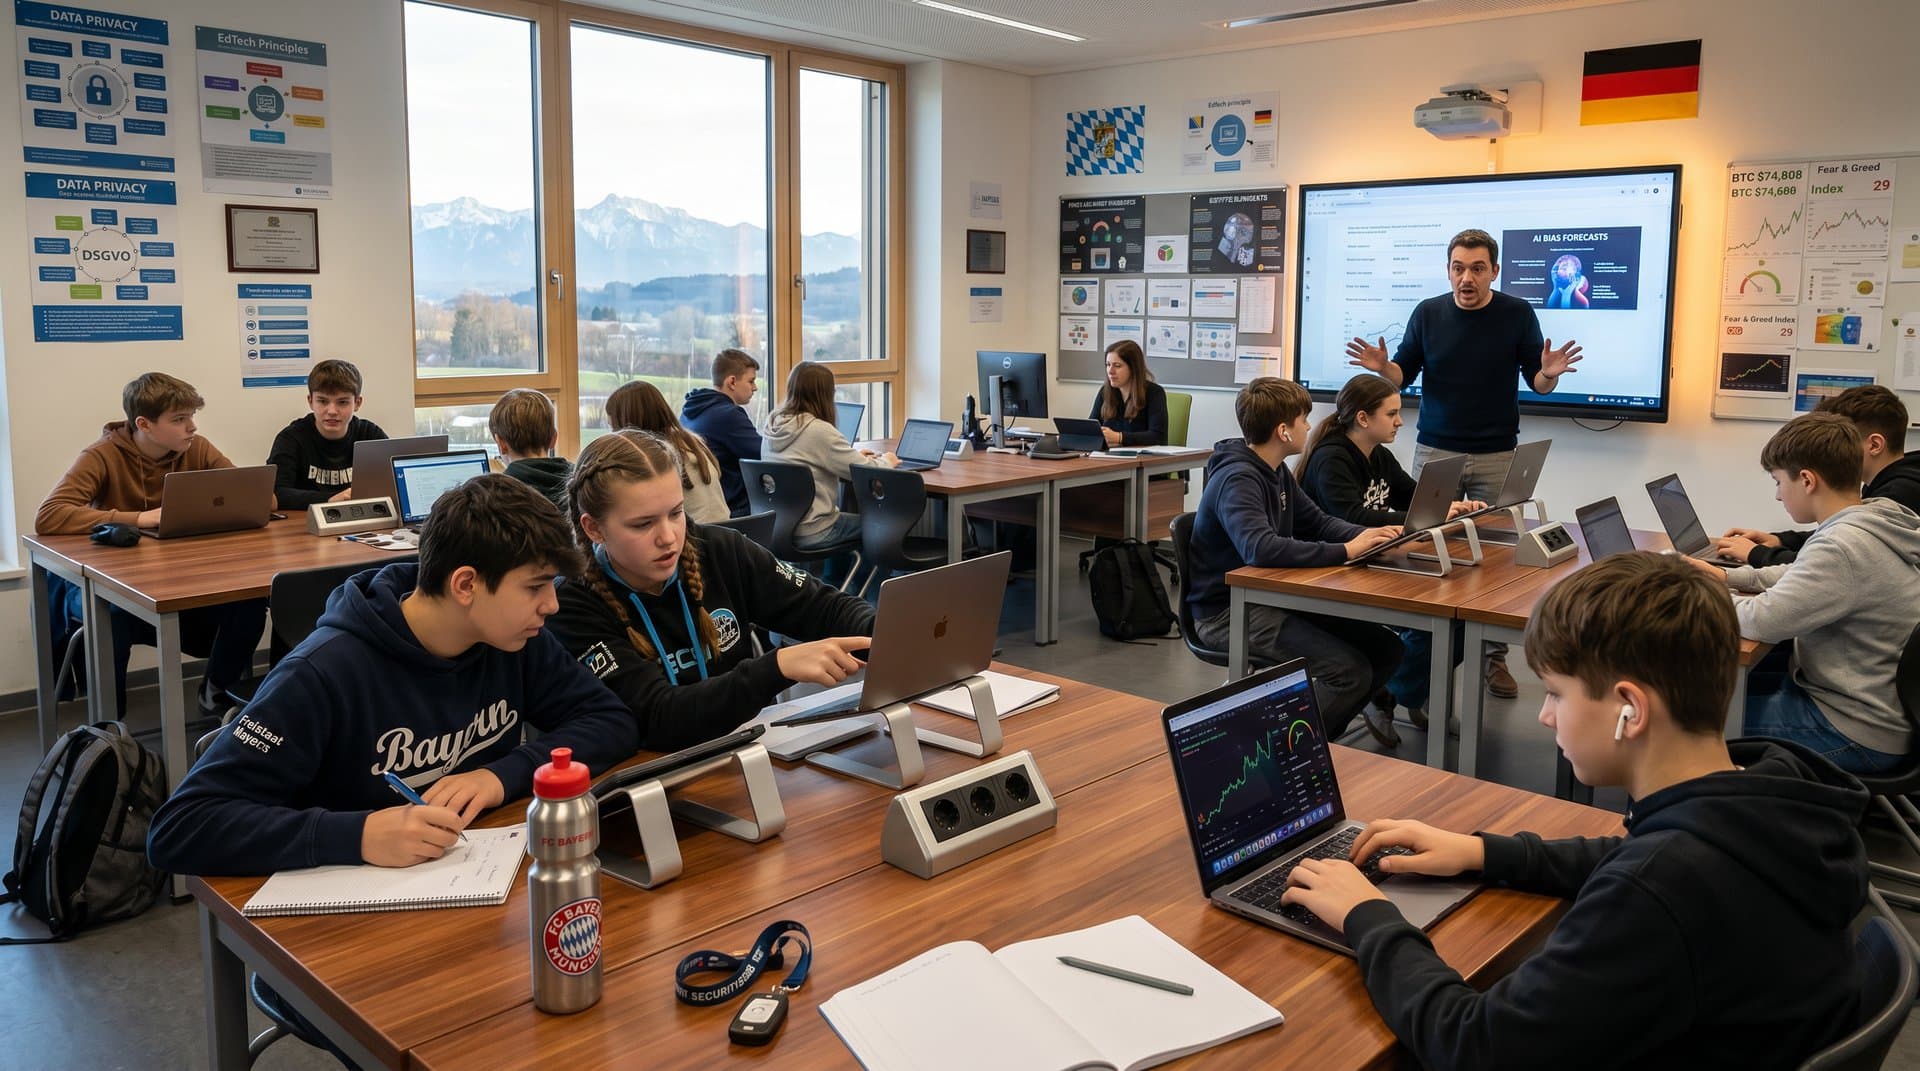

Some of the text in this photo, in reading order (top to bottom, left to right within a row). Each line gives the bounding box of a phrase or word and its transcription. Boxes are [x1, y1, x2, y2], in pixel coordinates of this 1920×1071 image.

[50, 9, 83, 24] DATA
[86, 14, 138, 32] PRIVACY
[217, 33, 309, 55] EdTech Principles
[1817, 163, 1881, 174] Fear & Greed
[1732, 169, 1803, 183] BTC $74,808
[57, 179, 148, 194] DATA PRIVACY
[1731, 188, 1752, 198] BTC
[1811, 179, 1890, 194] Index 29
[1533, 232, 1609, 243] AI BIAS FORECASTS
[82, 250, 131, 261] DSGVO
[1724, 315, 1796, 324] Fear & Greed Index
[1780, 328, 1793, 337] 29
[371, 699, 517, 777] Bayern
[548, 918, 564, 936] FC
